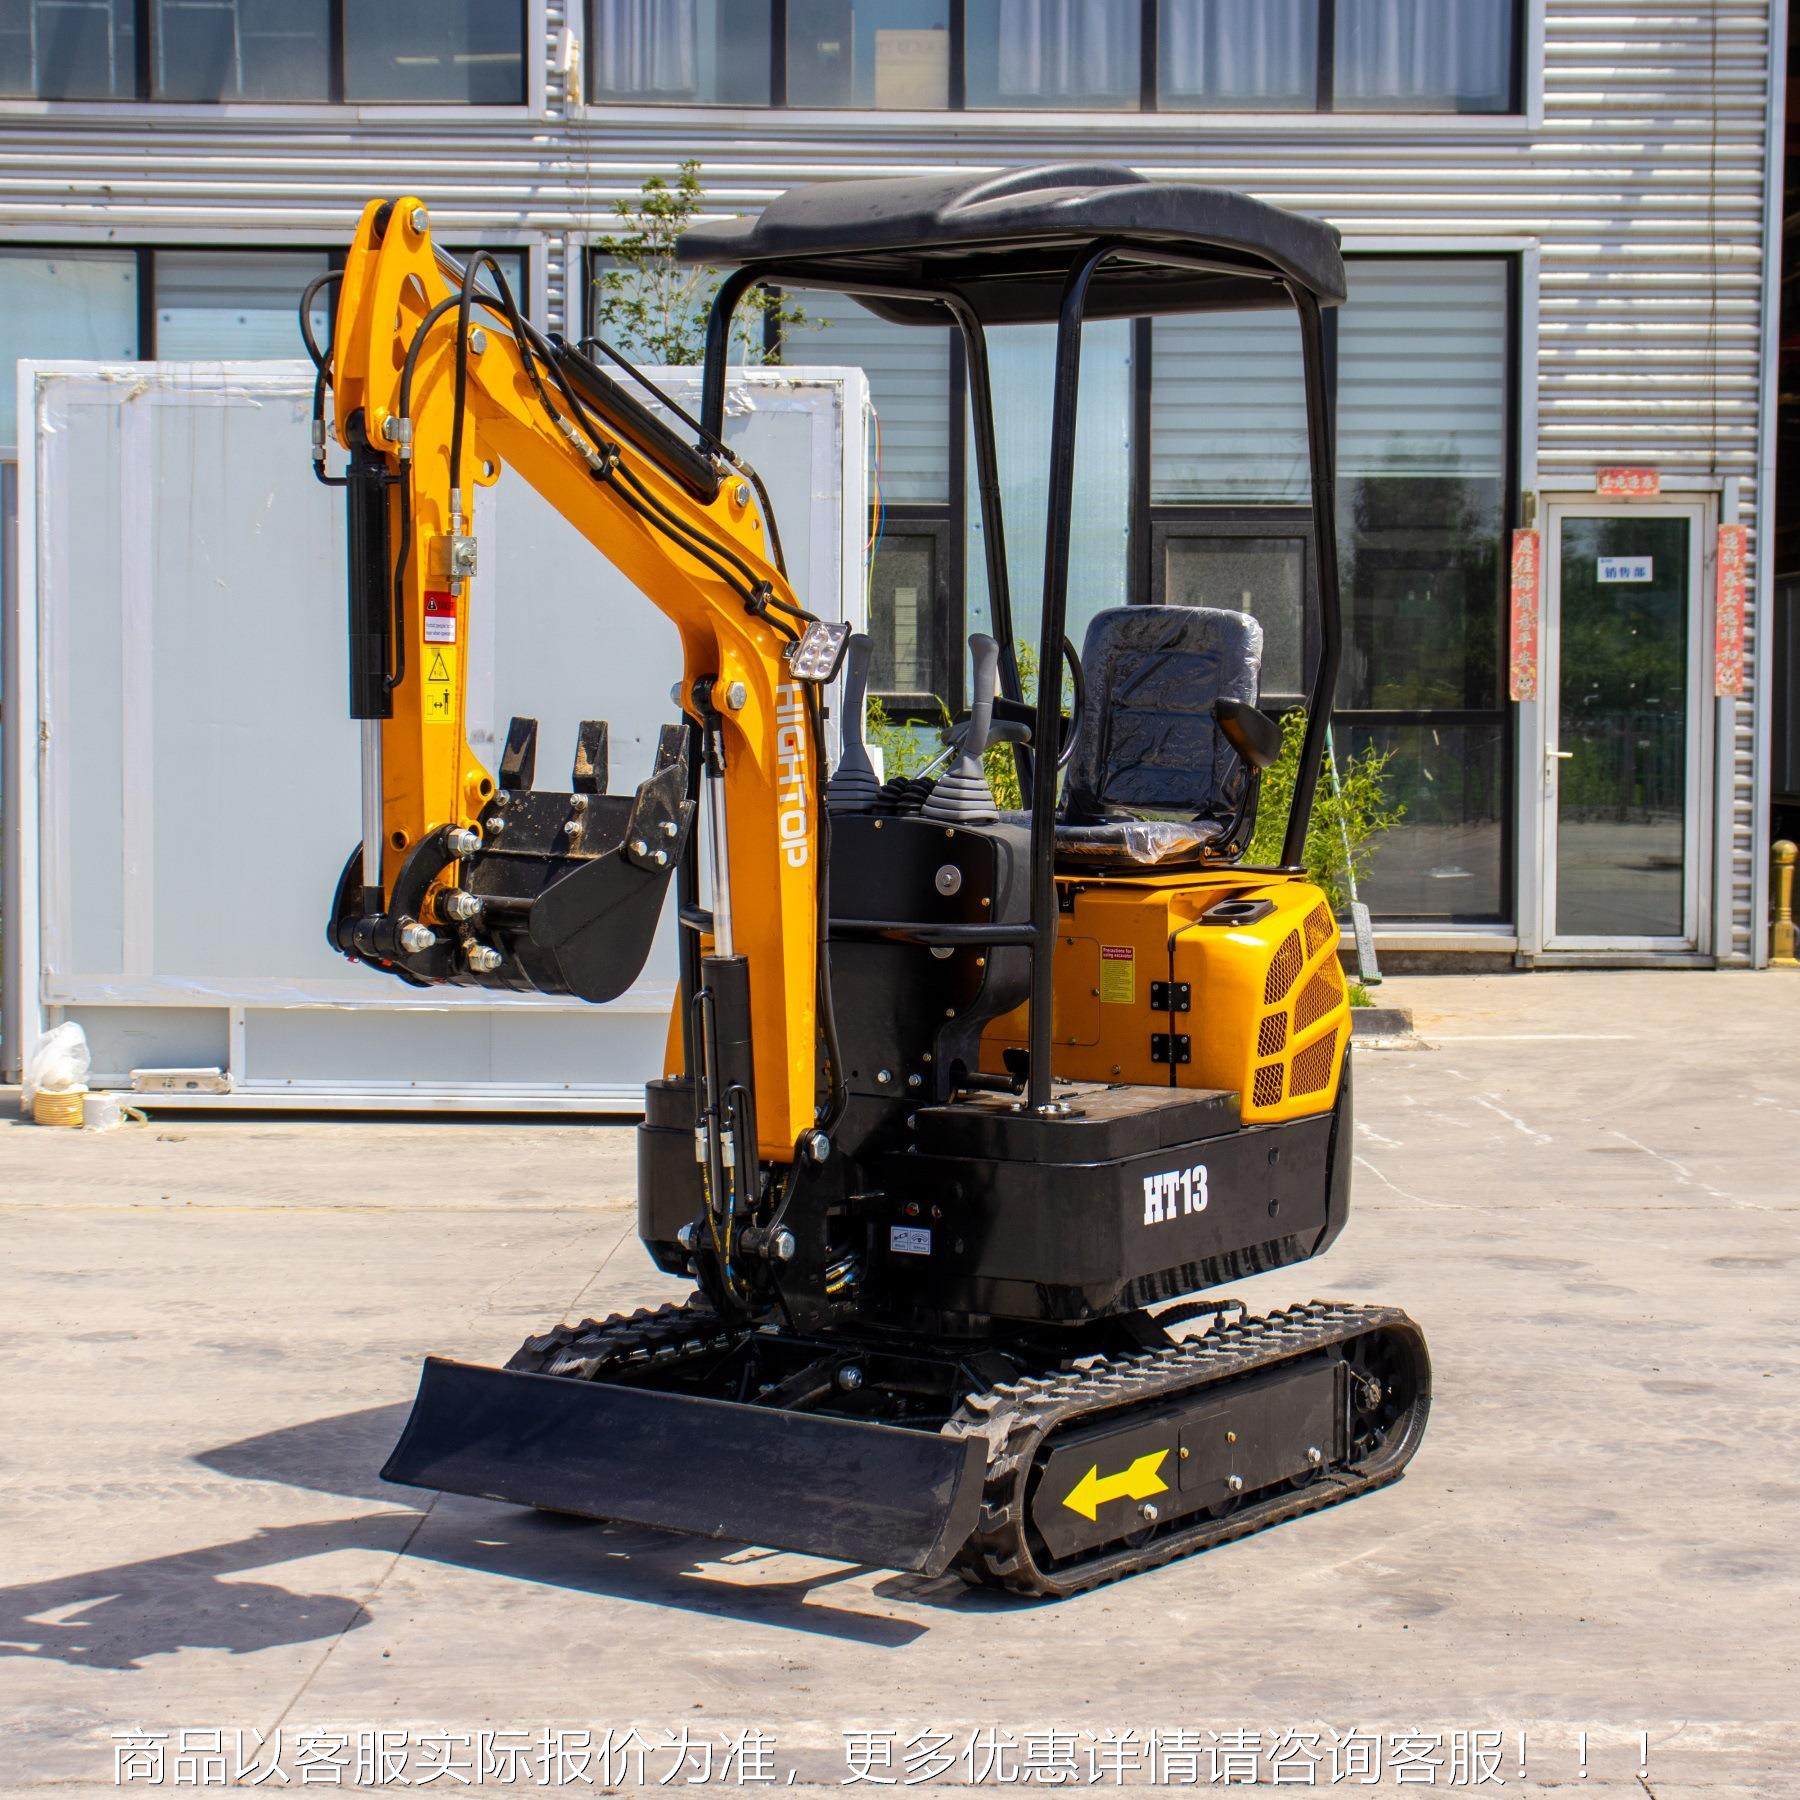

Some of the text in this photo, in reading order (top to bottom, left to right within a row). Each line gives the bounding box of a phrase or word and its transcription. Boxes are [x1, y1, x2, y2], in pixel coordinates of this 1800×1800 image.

[1605, 566, 1646, 578] 销售部
[775, 682, 808, 868] HIGHTOP
[1143, 1164, 1208, 1226] HT13
